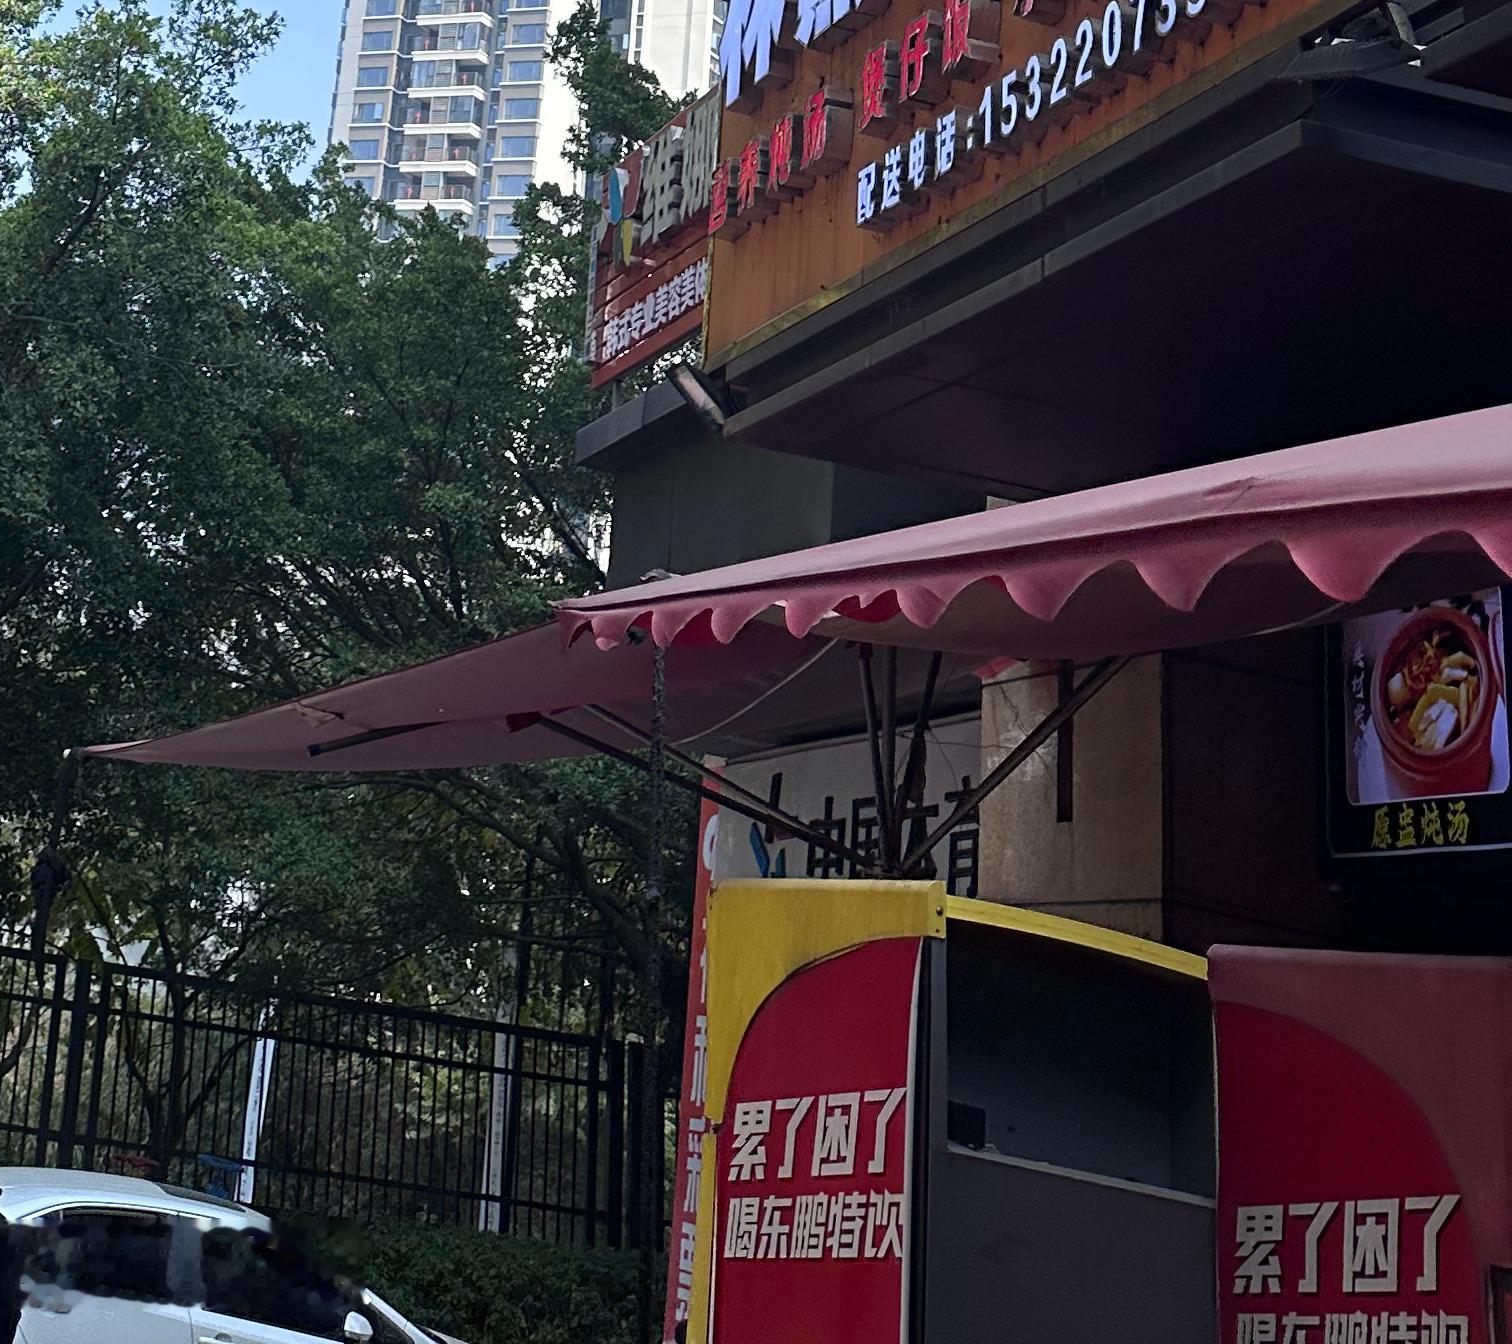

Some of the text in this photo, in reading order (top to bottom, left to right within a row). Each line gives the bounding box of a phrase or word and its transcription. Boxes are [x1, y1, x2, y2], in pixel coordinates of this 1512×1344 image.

[727, 1087, 907, 1182] 累了困了
[723, 1188, 905, 1259] 喝东鹏特饮
[1232, 1194, 1462, 1294] 累了困了
